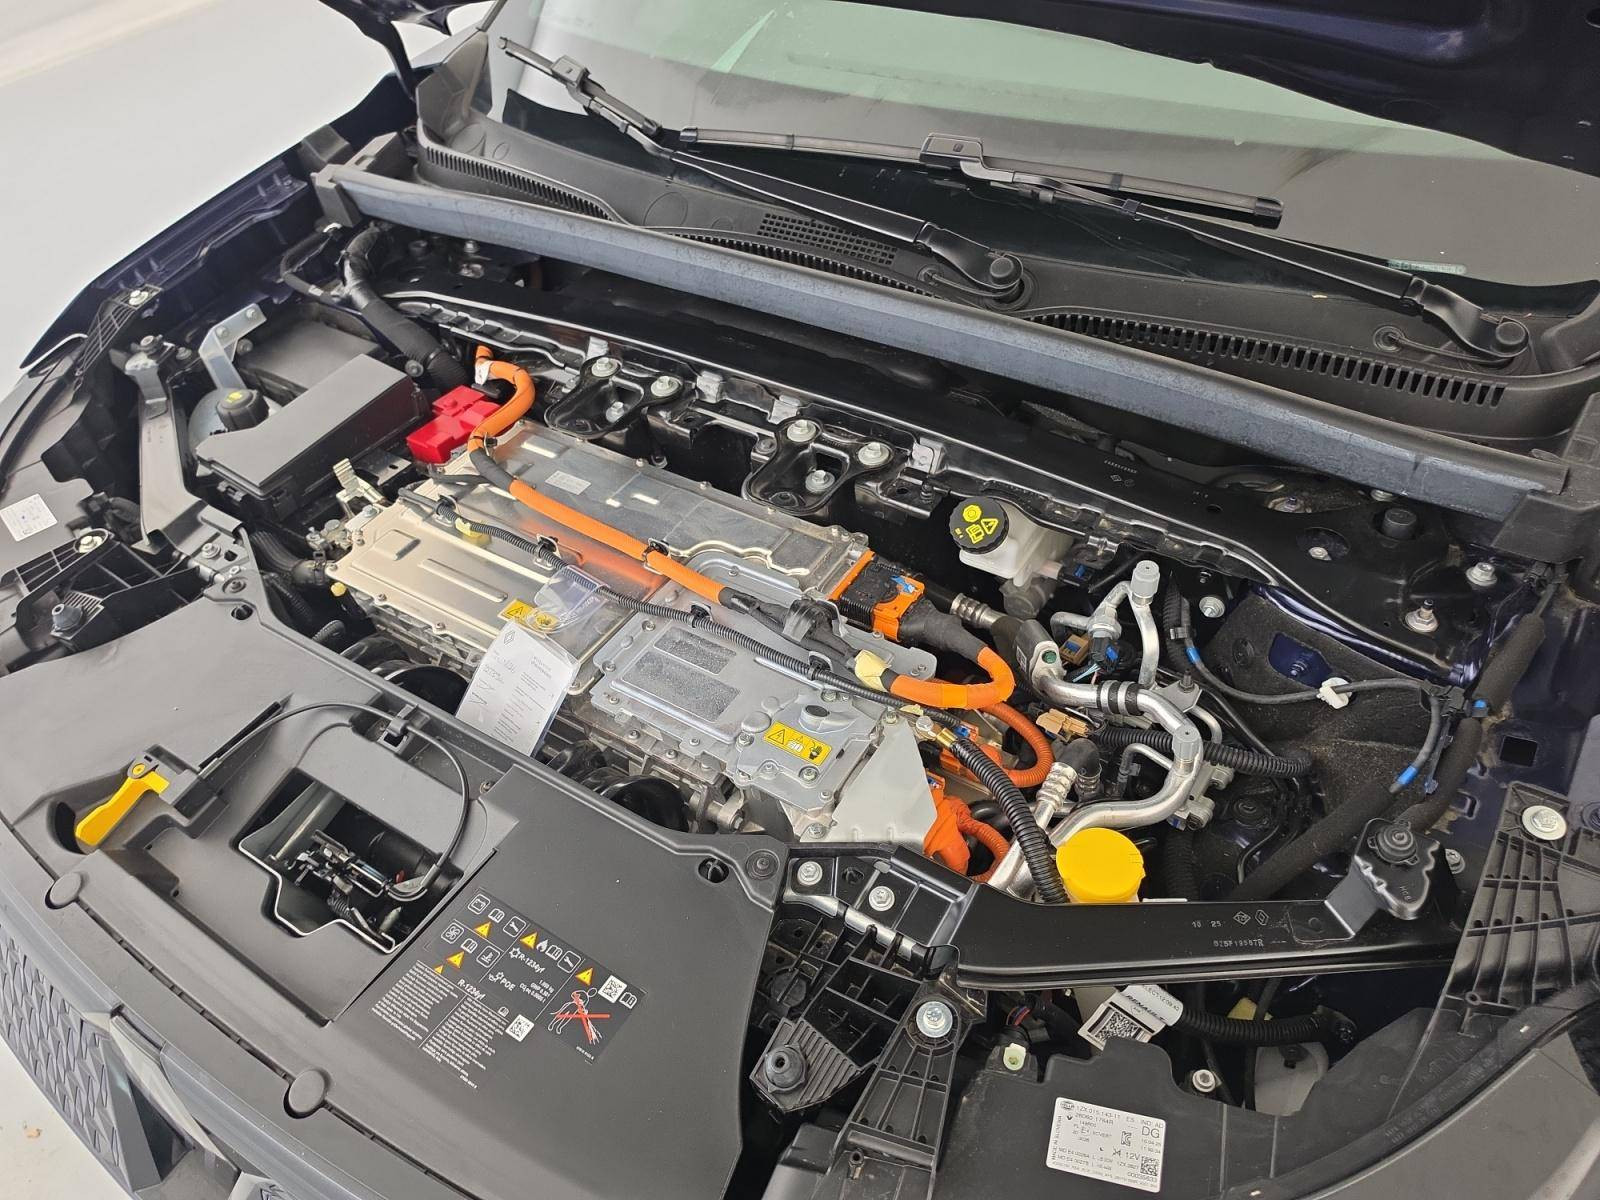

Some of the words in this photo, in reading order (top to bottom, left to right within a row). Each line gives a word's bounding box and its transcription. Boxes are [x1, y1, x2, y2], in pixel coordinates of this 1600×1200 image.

[518, 953, 546, 974] R-1234yf
[457, 978, 486, 1001] R-1234yf
[500, 977, 516, 991] POE
[1141, 1126, 1160, 1138] DG
